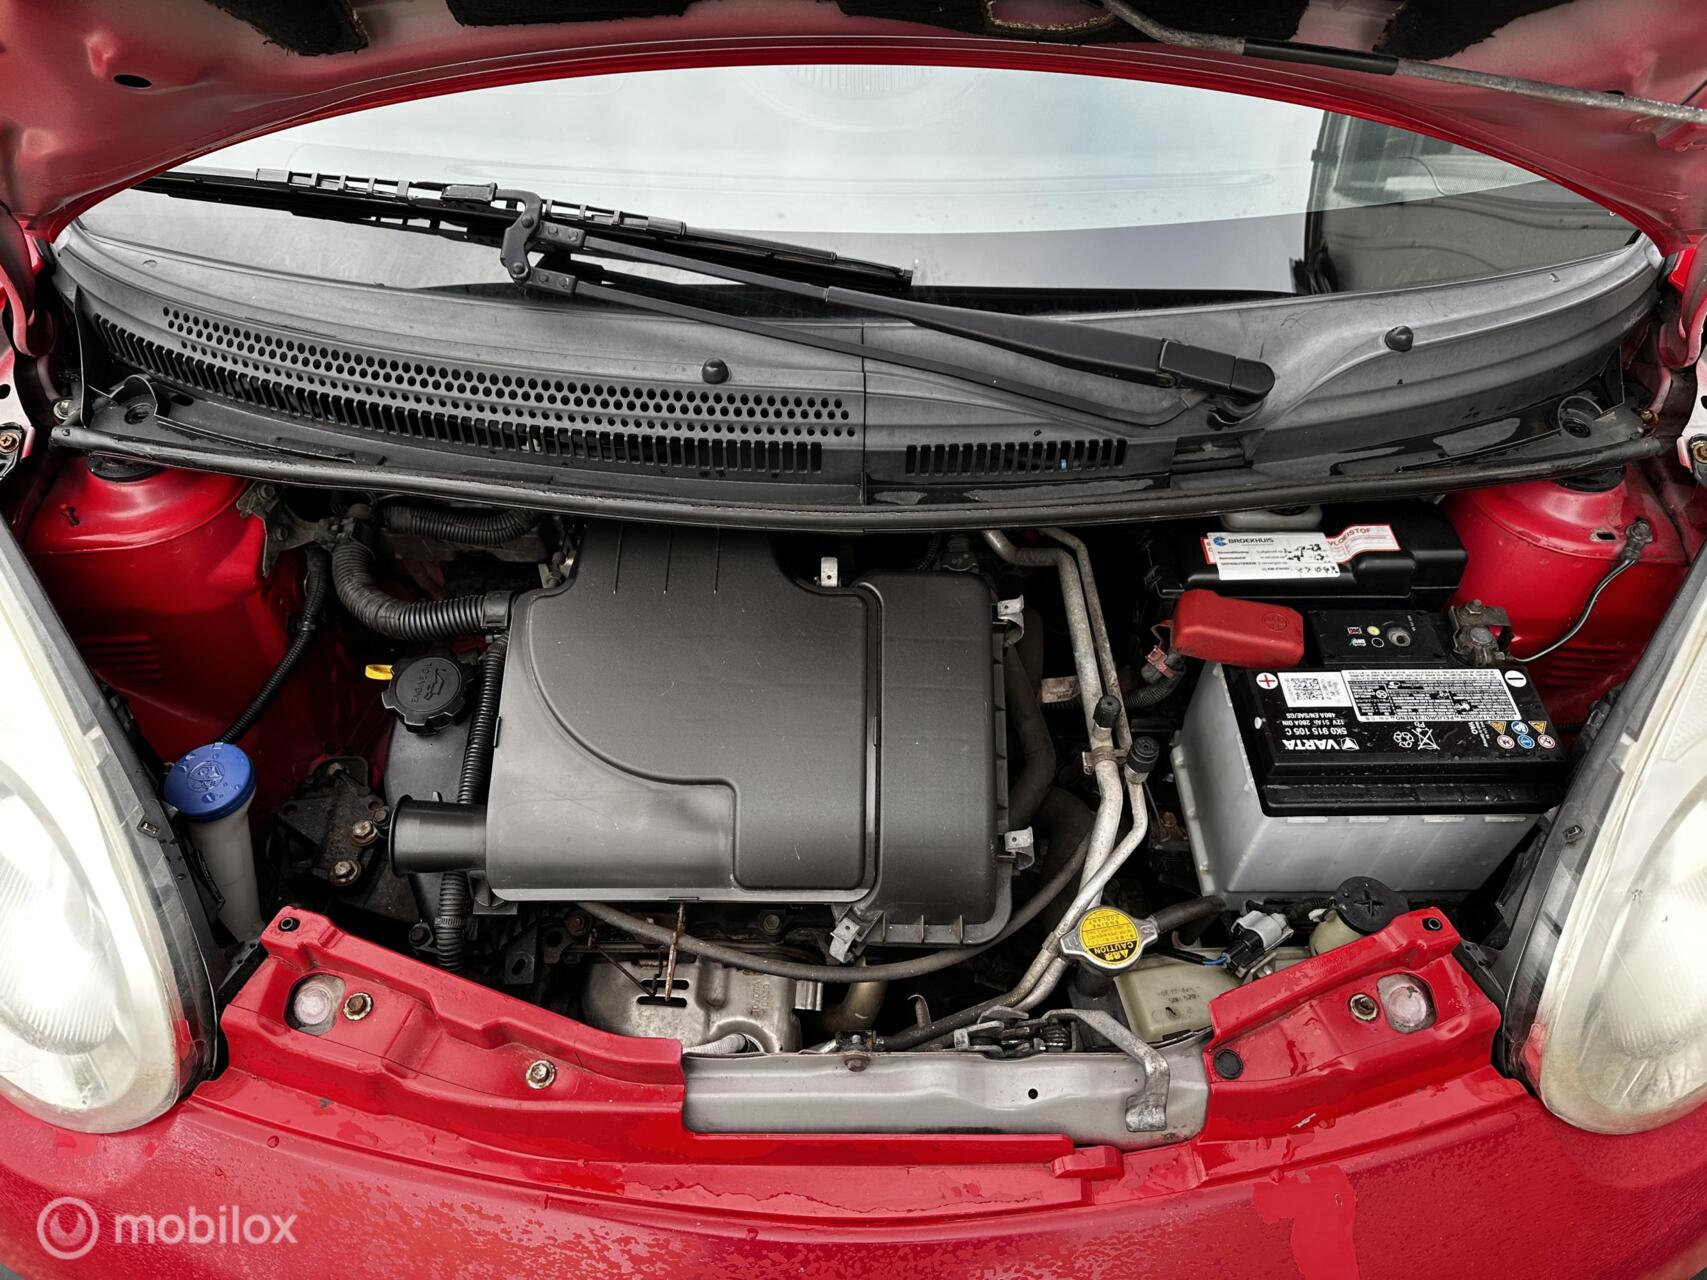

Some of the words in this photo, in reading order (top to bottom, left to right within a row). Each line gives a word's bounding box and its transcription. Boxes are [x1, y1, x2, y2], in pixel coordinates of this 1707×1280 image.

[1284, 727, 1292, 735] C
[1293, 727, 1311, 735] 105
[1312, 727, 1329, 735] 915
[1281, 739, 1341, 750] VARTA
[1093, 941, 1134, 954] CAUTION
